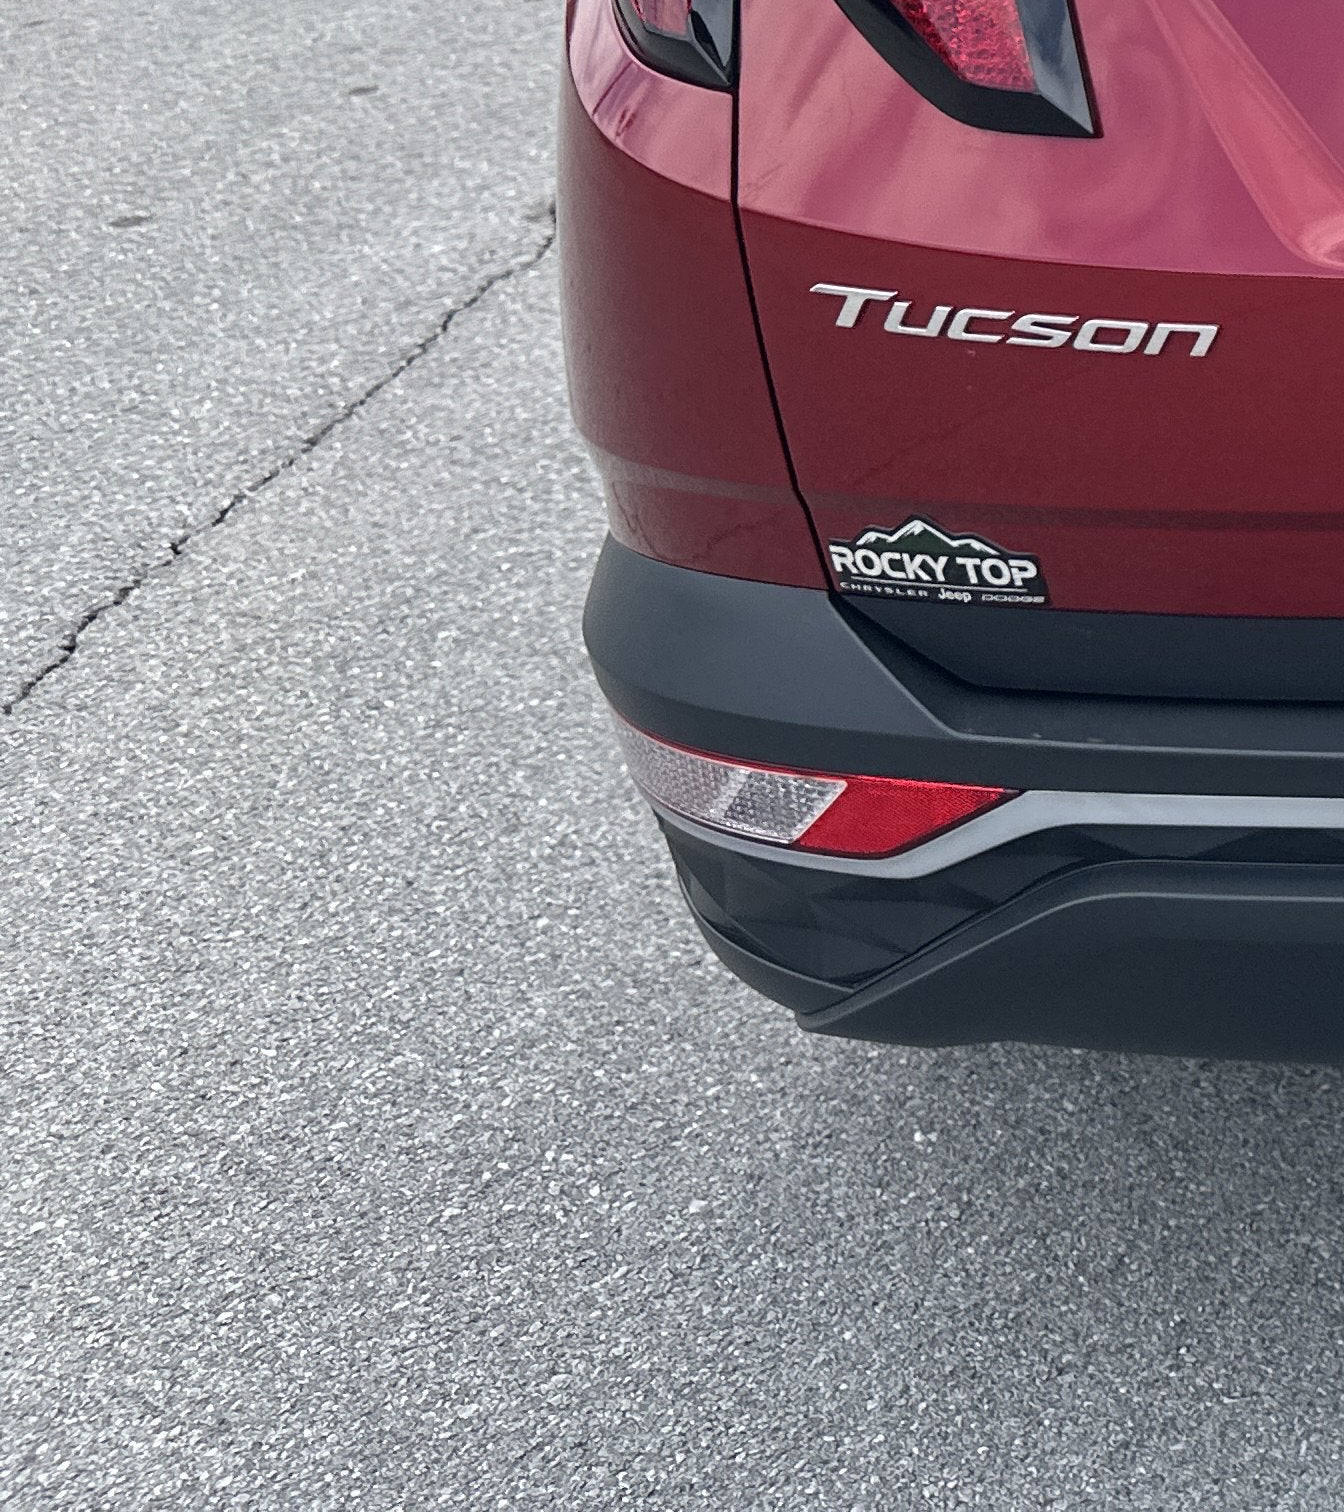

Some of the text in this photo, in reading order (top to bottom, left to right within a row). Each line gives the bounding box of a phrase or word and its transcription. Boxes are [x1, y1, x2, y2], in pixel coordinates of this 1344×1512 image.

[809, 282, 1220, 358] Tucson
[828, 544, 1038, 587] ROCKY TOP
[839, 581, 929, 597] CHRYSLER
[937, 587, 973, 603] Jeep
